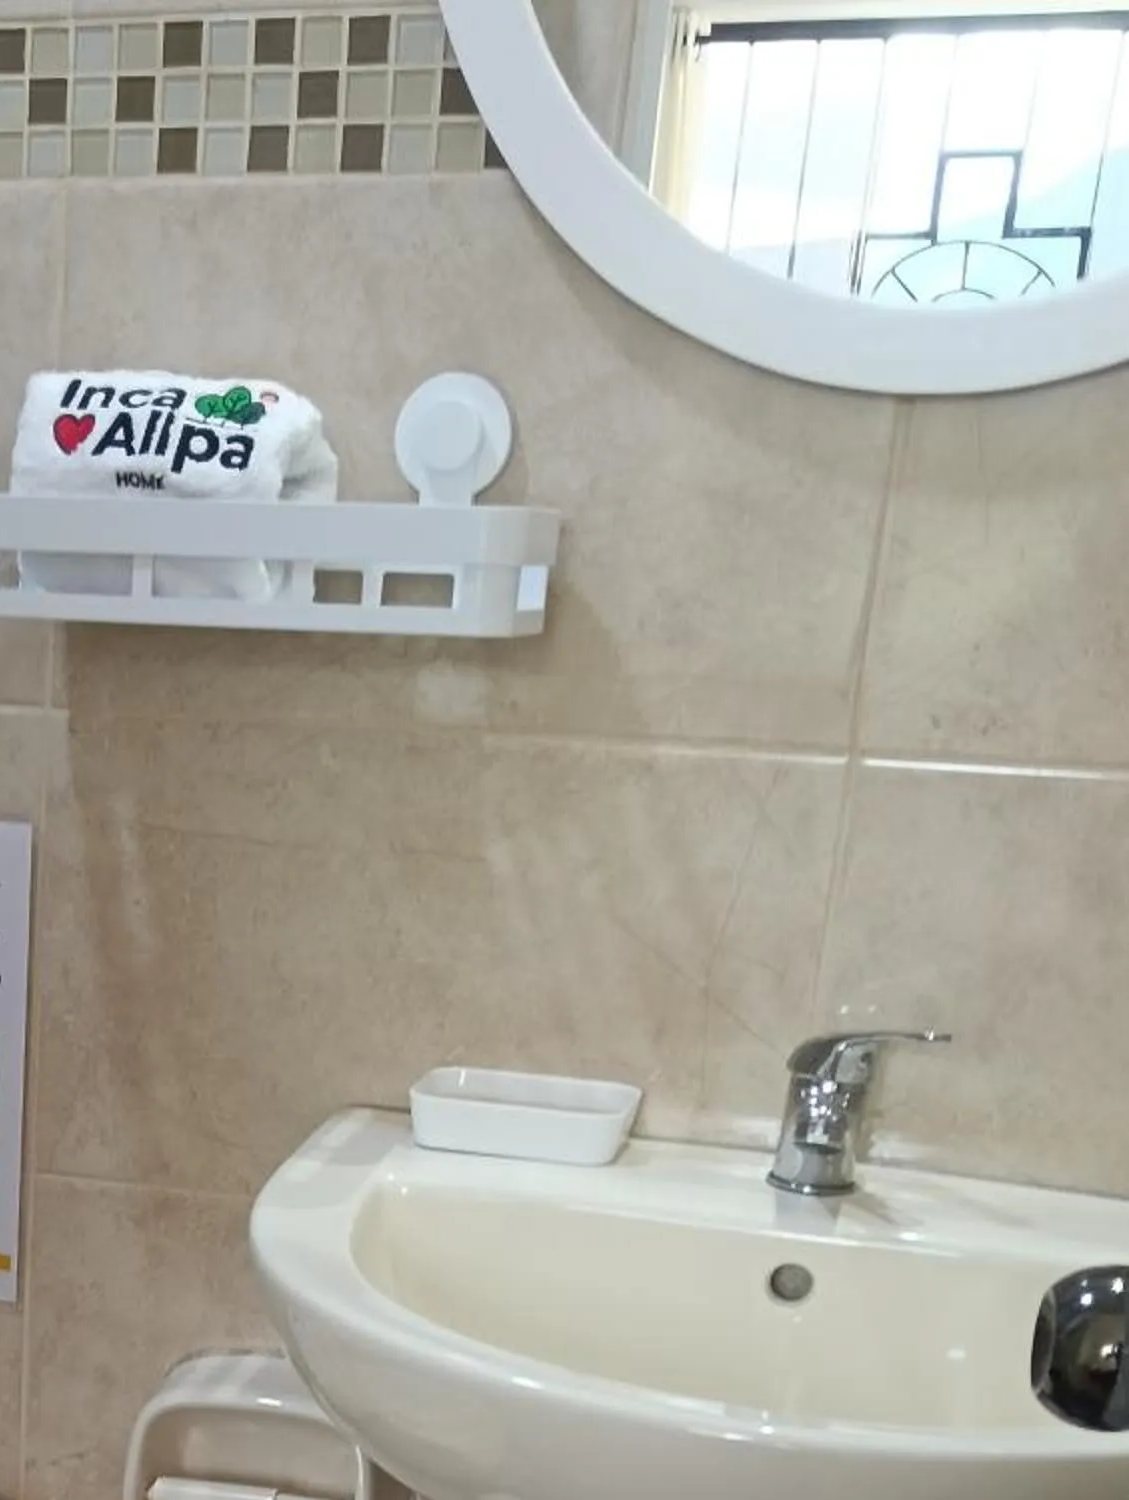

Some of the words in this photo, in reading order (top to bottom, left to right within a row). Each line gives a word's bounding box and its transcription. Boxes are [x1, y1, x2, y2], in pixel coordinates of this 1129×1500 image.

[60, 379, 188, 409] Inca
[91, 410, 255, 473] Allpa
[116, 471, 167, 490] HOME
